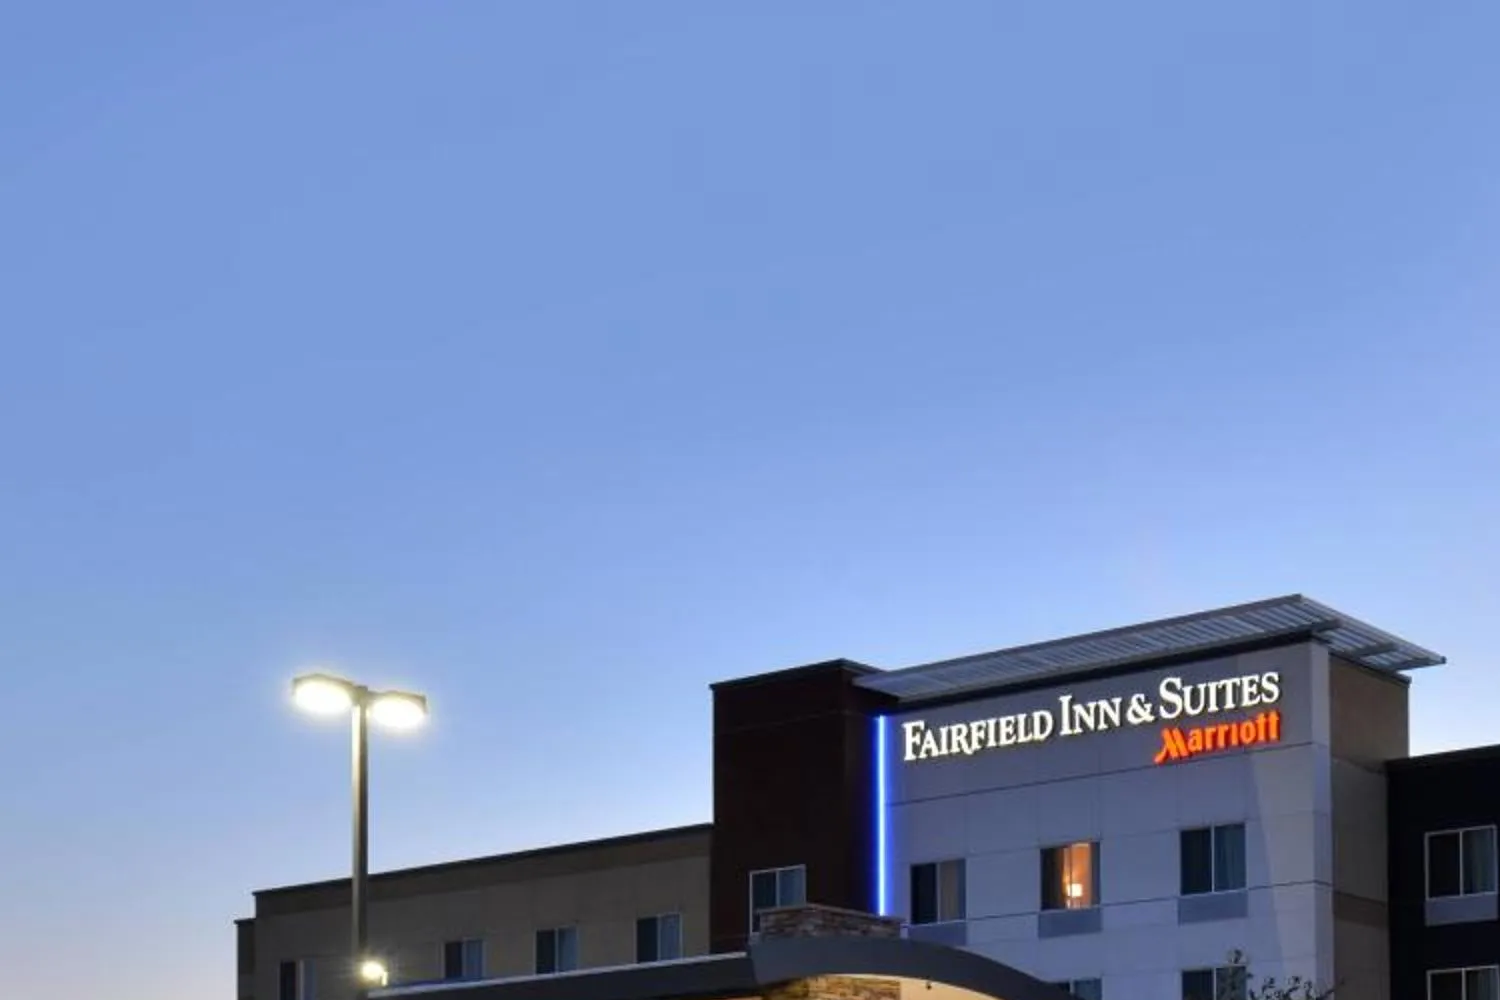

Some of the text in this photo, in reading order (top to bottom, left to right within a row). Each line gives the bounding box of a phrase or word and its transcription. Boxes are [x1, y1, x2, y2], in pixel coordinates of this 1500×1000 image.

[902, 671, 1281, 761] FAIRFIELD INN & SUITES
[1154, 710, 1281, 764] Marriott
